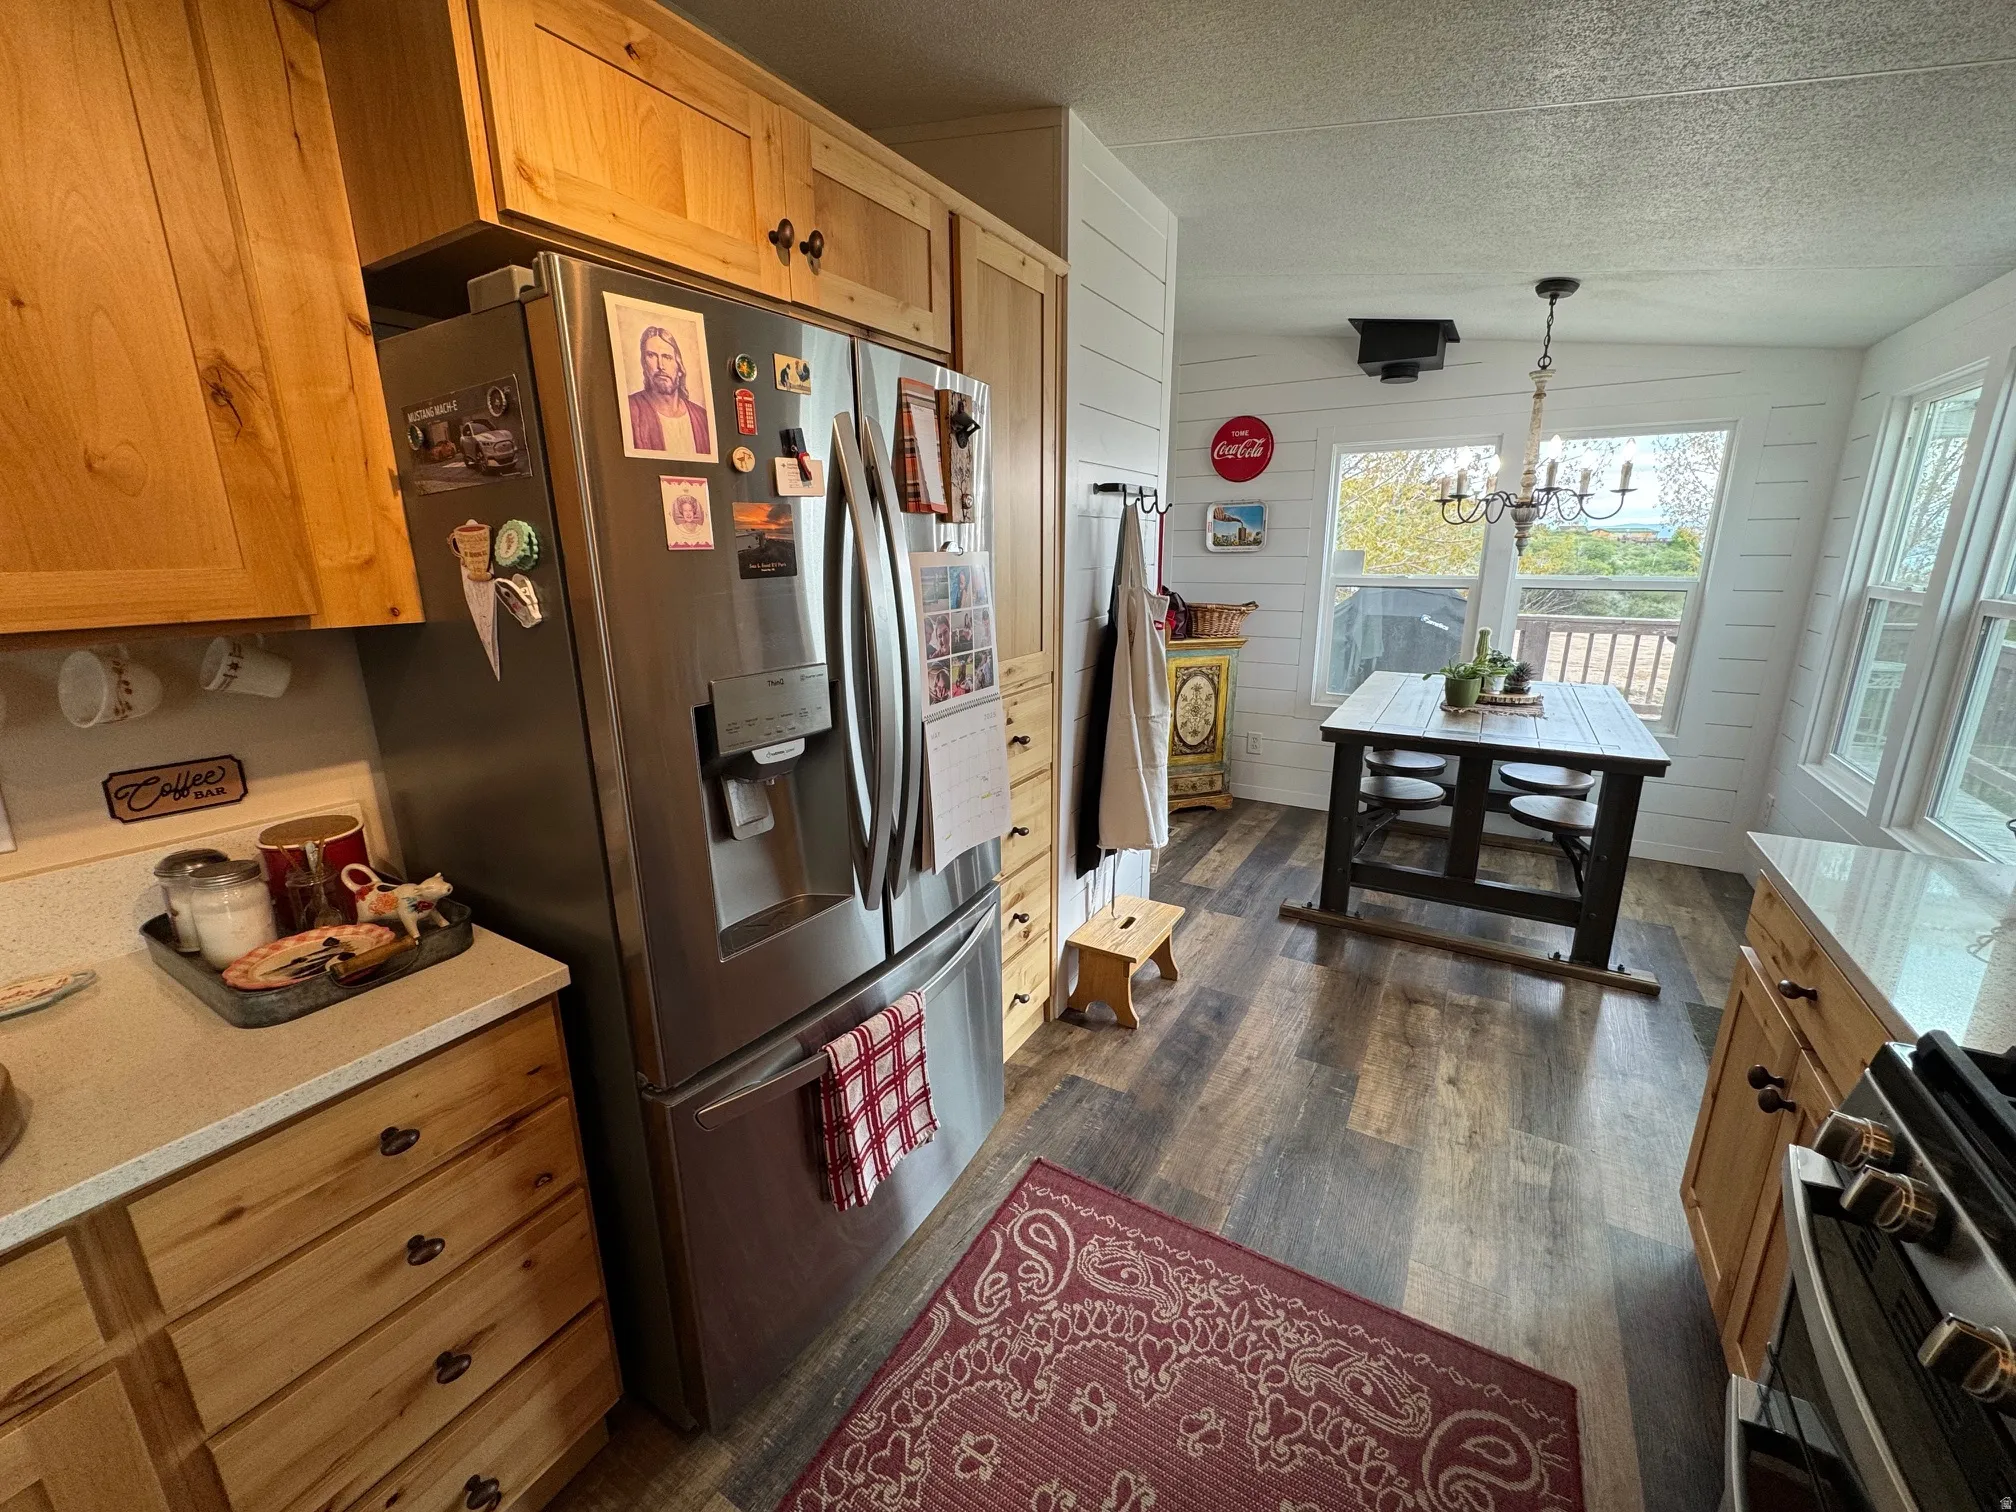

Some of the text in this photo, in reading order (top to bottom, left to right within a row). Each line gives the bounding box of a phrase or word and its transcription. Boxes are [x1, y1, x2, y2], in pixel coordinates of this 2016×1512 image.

[407, 400, 458, 423] MUSTANG MACH-E
[767, 678, 784, 687] ThinQ
[114, 765, 226, 812] Coffee
[193, 786, 227, 800] BAR
